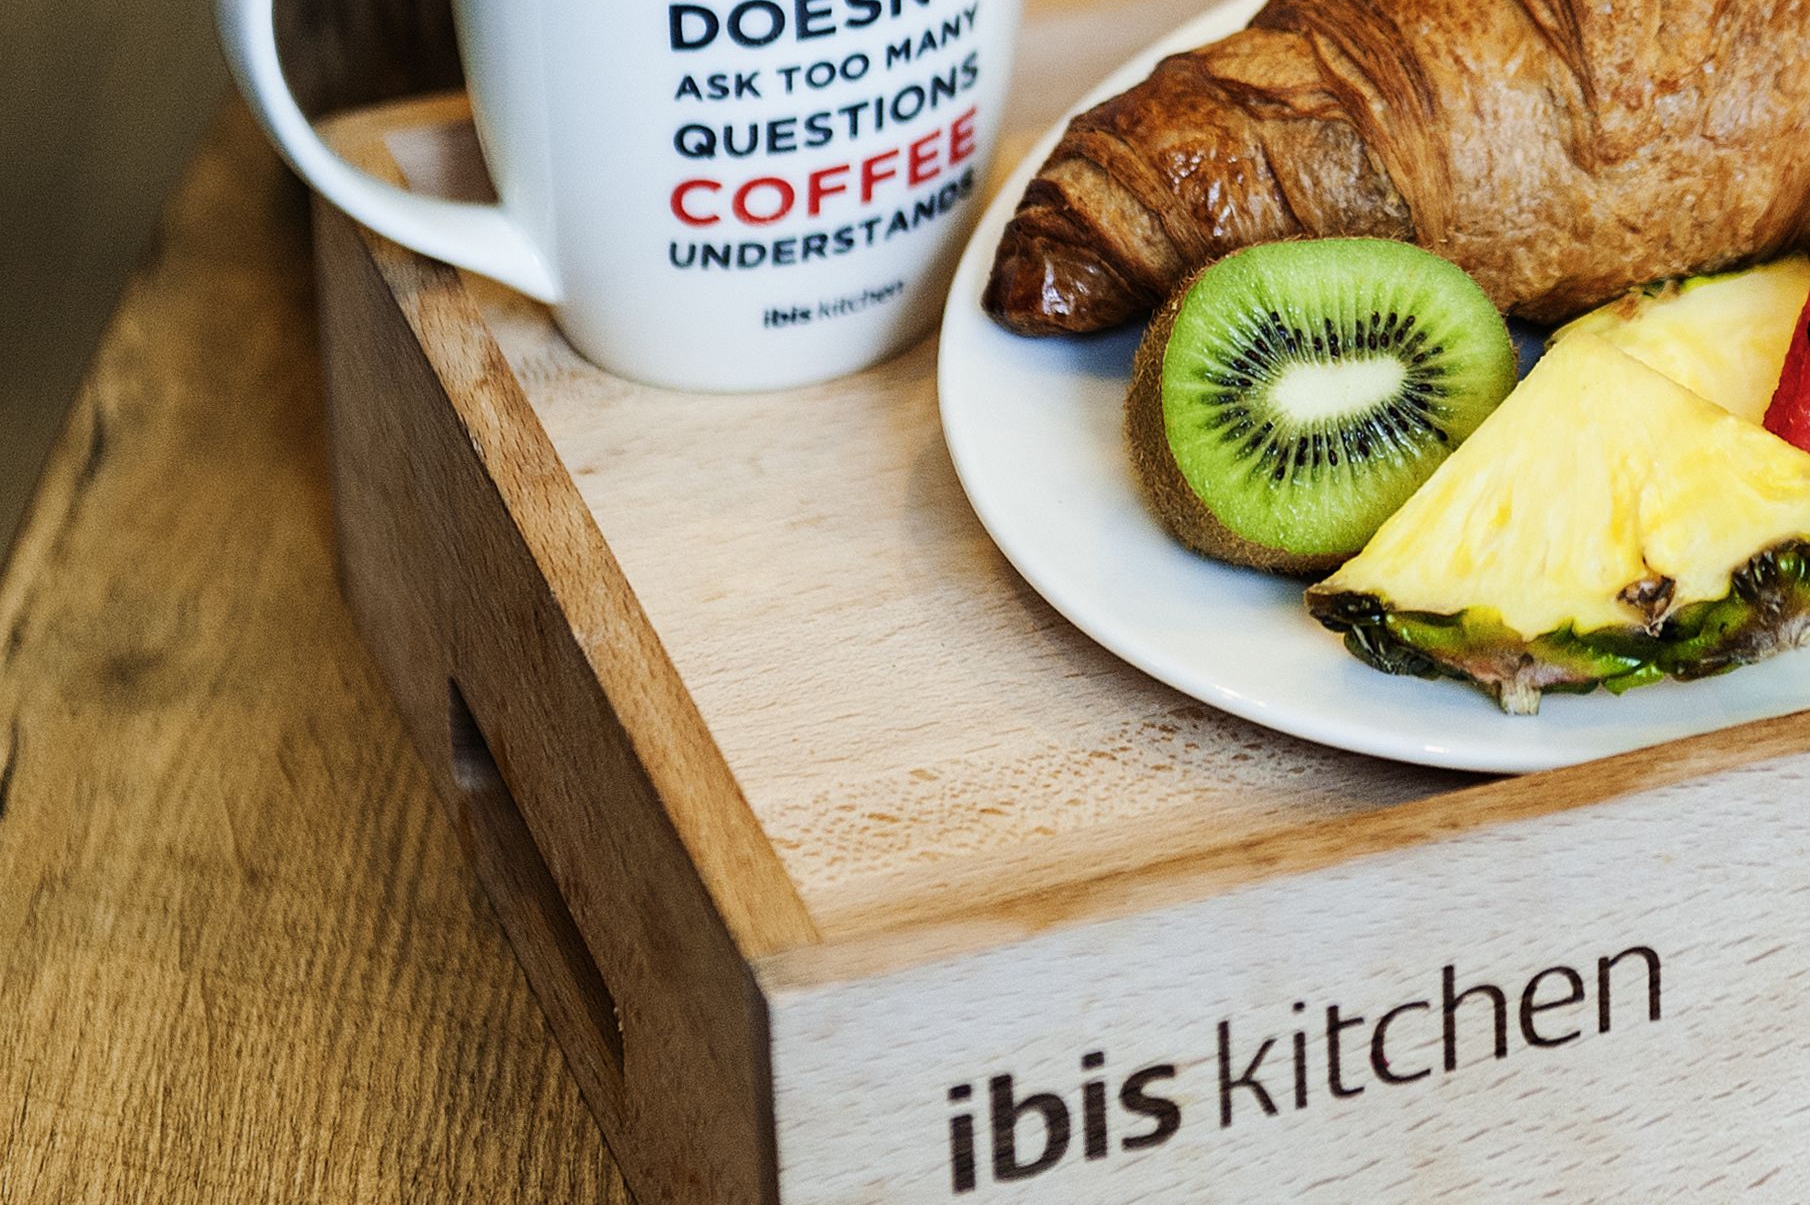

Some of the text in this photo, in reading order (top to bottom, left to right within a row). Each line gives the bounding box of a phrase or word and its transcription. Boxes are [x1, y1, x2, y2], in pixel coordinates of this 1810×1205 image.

[672, 52, 979, 160] QUESTIONS
[673, 2, 979, 102] ASK TOO MANY
[670, 106, 978, 228] COFFEE
[763, 304, 812, 329] ibis
[946, 942, 1664, 1196] ibis kitchen
